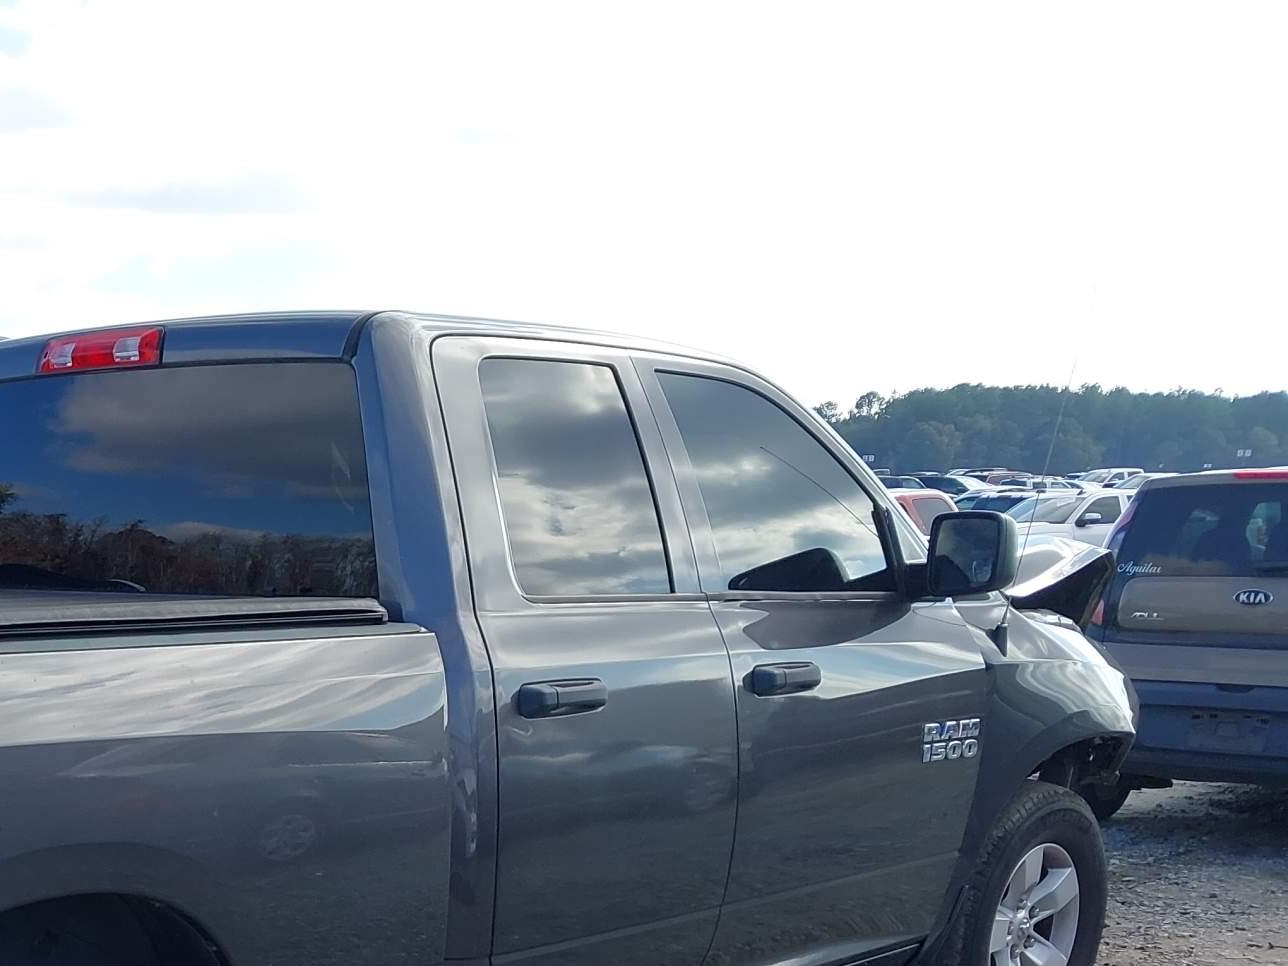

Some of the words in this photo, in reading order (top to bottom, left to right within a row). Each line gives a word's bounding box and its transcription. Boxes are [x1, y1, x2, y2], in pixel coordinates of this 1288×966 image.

[1238, 592, 1266, 604] KIA
[923, 718, 981, 742] RAM
[922, 739, 978, 763] 1500
